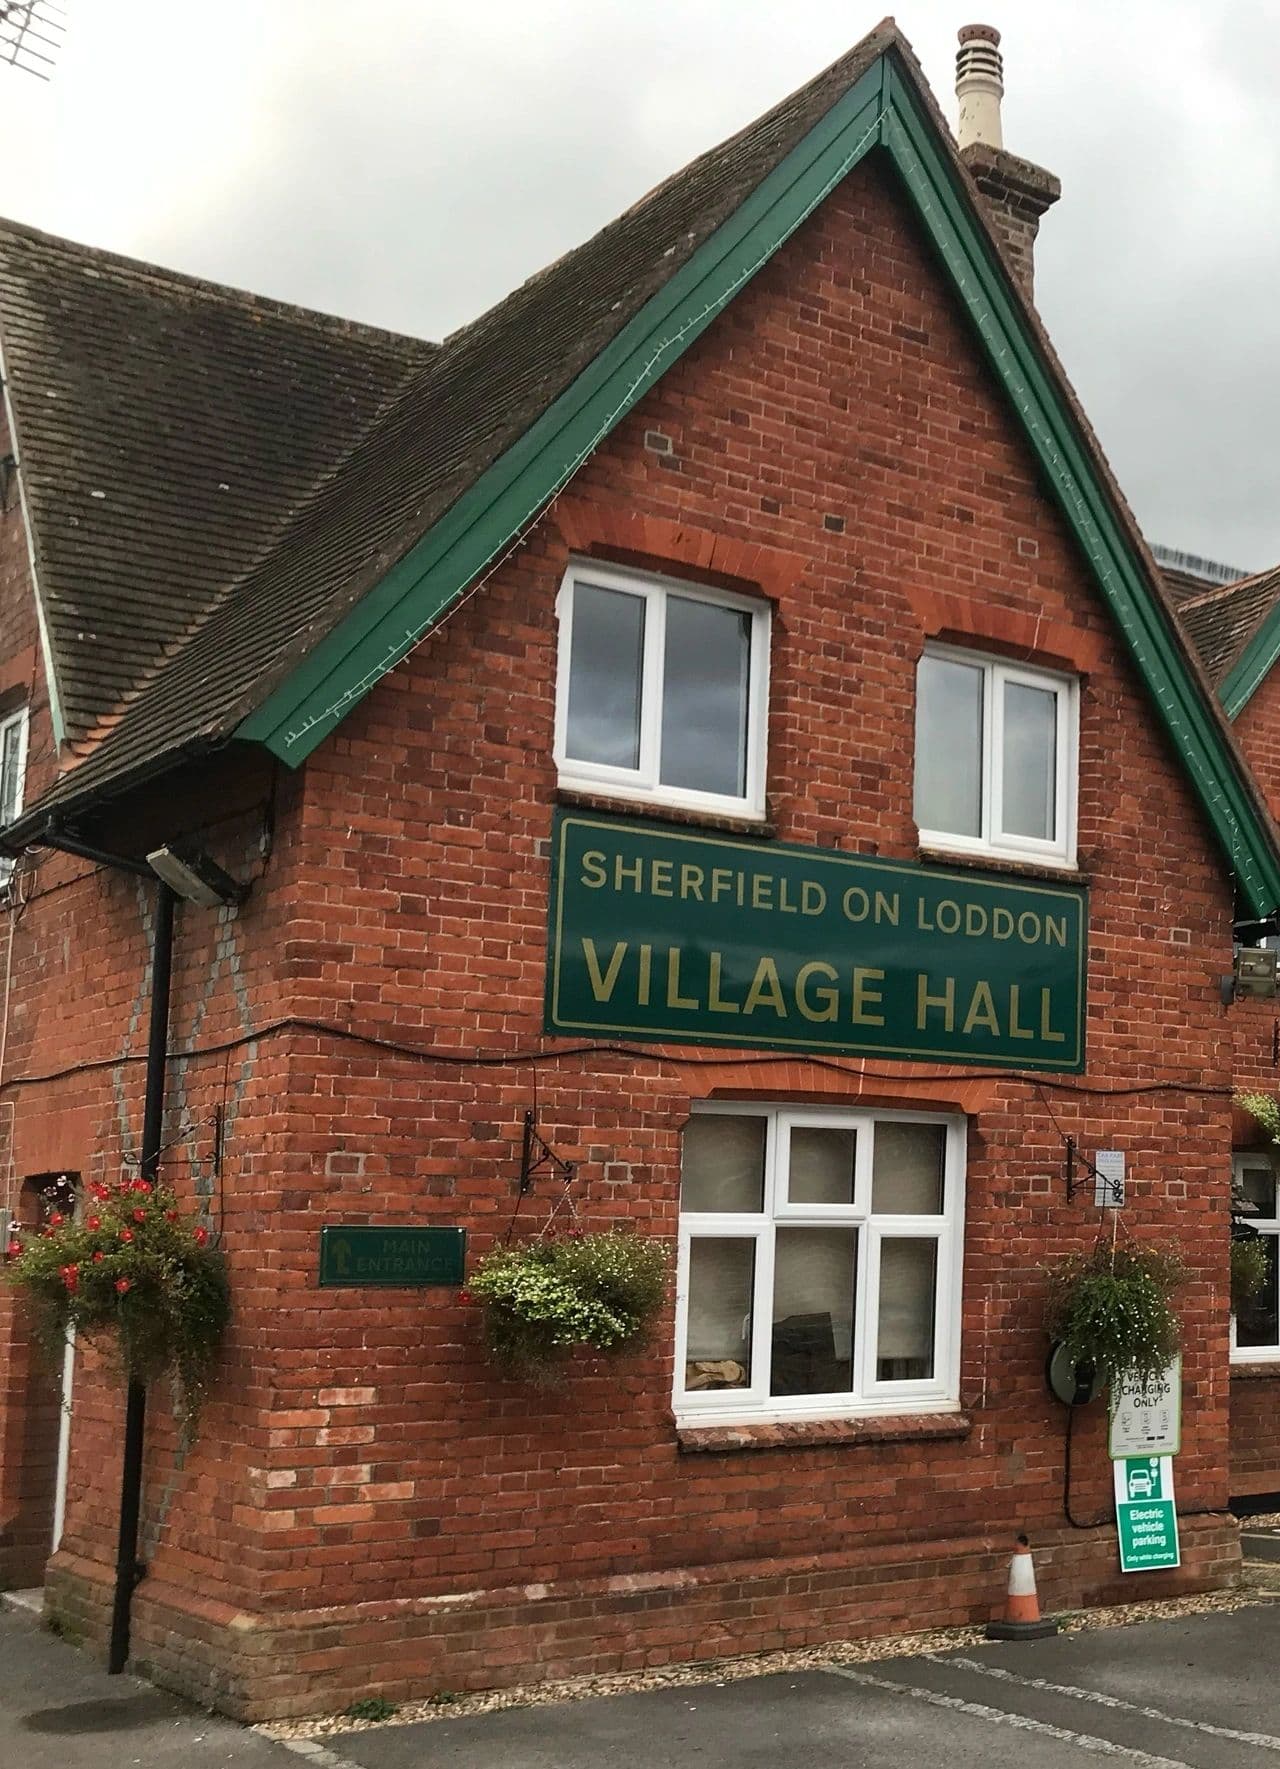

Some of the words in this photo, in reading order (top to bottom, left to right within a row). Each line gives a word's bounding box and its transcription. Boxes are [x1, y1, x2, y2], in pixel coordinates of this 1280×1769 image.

[580, 850, 827, 917] SHERFIELD
[843, 887, 900, 926] ON
[917, 897, 1067, 947] LODDON
[581, 937, 886, 1027] VILLAGE
[916, 974, 1065, 1042] HALL
[383, 1239, 431, 1254] MAIN
[356, 1256, 454, 1273] ENTRANCE
[1133, 1397, 1159, 1408] ONLY
[1129, 1508, 1165, 1521] Electric
[1131, 1521, 1165, 1533] vehicle
[1132, 1534, 1167, 1549] parking
[1152, 1552, 1175, 1561] charging
